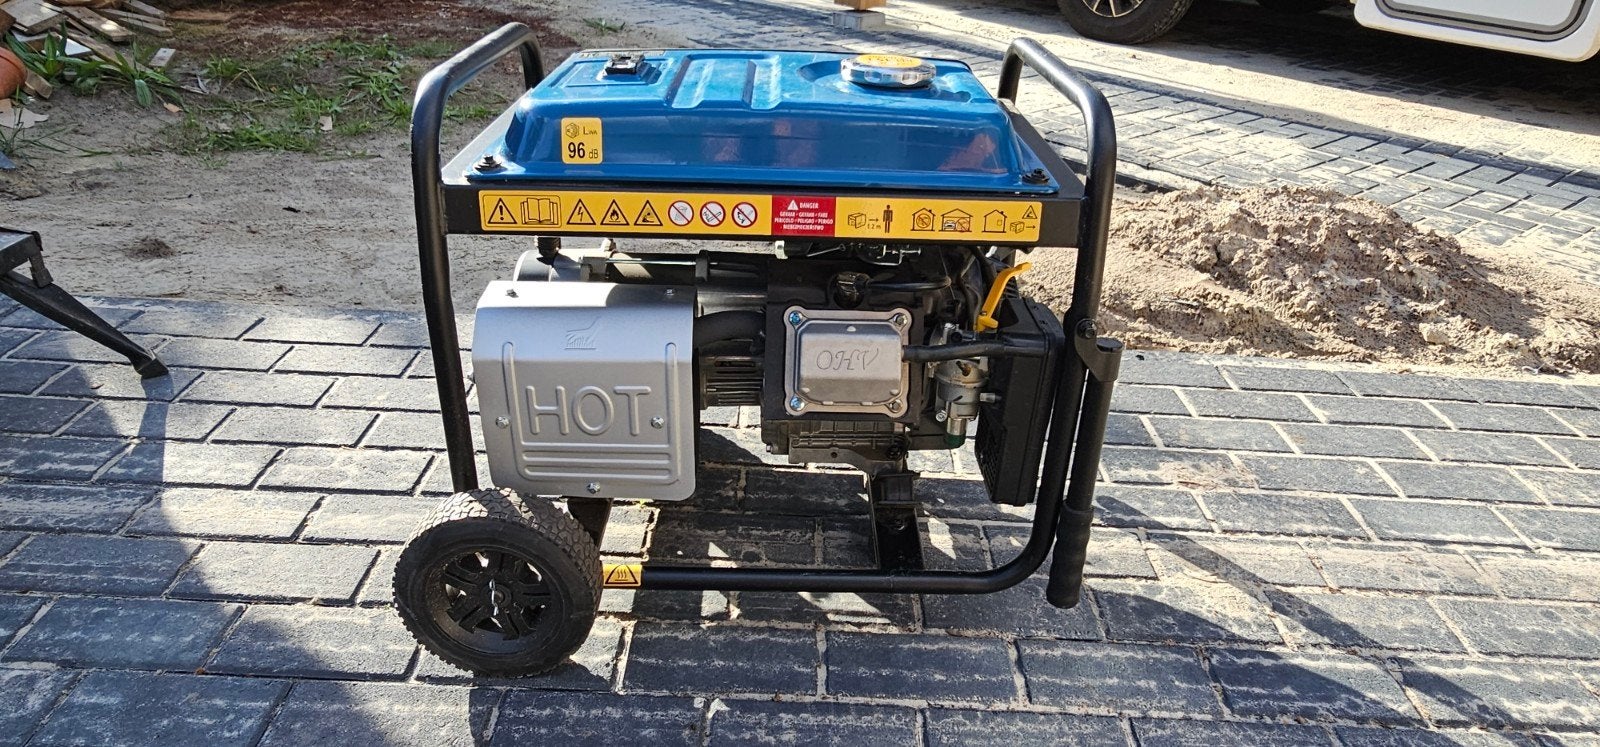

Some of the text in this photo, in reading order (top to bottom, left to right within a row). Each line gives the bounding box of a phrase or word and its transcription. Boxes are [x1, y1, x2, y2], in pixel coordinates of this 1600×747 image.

[568, 142, 599, 159] 96 dB
[526, 385, 652, 436] HOT
